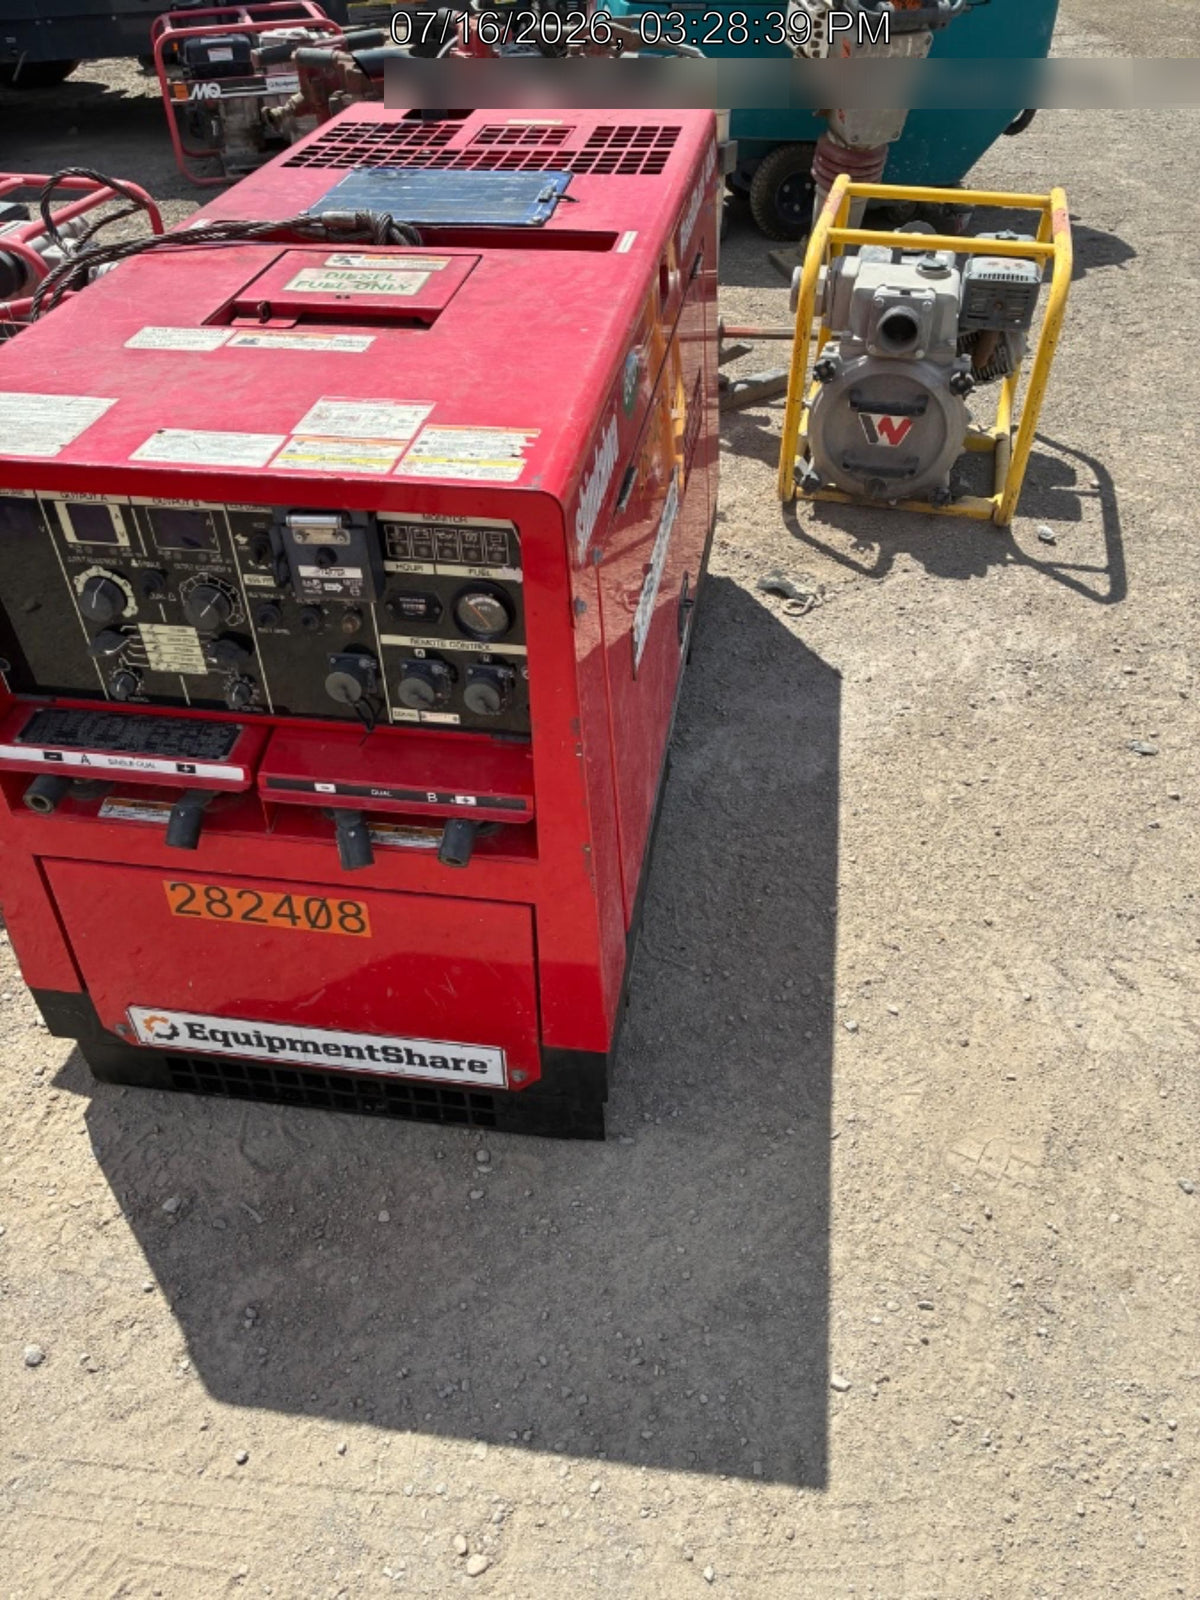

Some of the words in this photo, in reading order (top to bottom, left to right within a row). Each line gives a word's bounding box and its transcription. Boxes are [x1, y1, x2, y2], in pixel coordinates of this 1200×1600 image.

[324, 271, 397, 282] DIESEL
[294, 281, 347, 290] FUEL
[350, 280, 413, 291] ONLY
[395, 563, 424, 571] HOUR
[468, 568, 492, 576] FUEL
[409, 638, 446, 647] REMOTE
[448, 641, 492, 651] CONTROL
[80, 754, 91, 765] A
[426, 792, 438, 803] B
[169, 882, 367, 934] 282408
[184, 1020, 488, 1075] EquipmentShare
